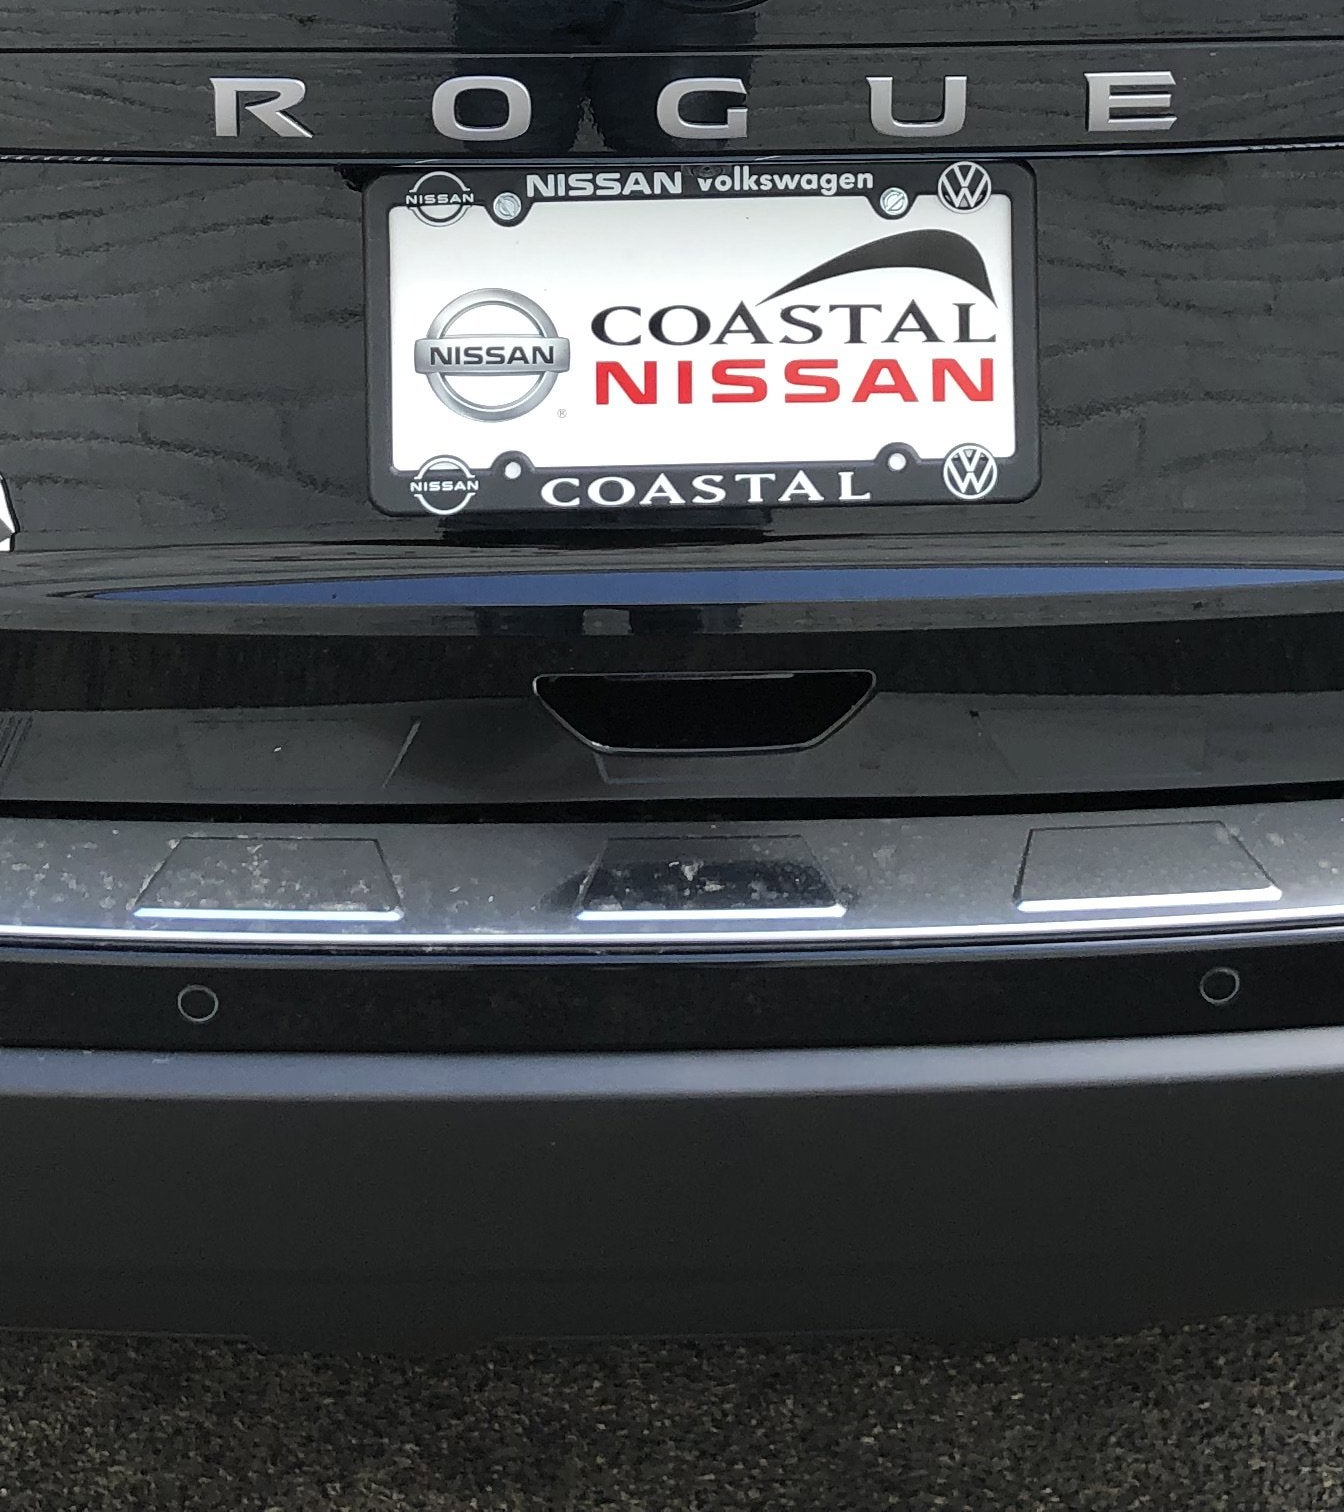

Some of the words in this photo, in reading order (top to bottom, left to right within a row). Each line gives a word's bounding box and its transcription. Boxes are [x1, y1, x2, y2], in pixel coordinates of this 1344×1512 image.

[210, 70, 1178, 140] ROGUE
[405, 192, 475, 205] NISSAN
[525, 170, 683, 198] NISSAN
[696, 165, 874, 197] volkswagen
[590, 299, 997, 347] COASTAL
[429, 345, 555, 366] NISSAN
[594, 357, 995, 405] NISSAN
[409, 479, 480, 493] NISSAN
[541, 470, 871, 507] COASTAL
